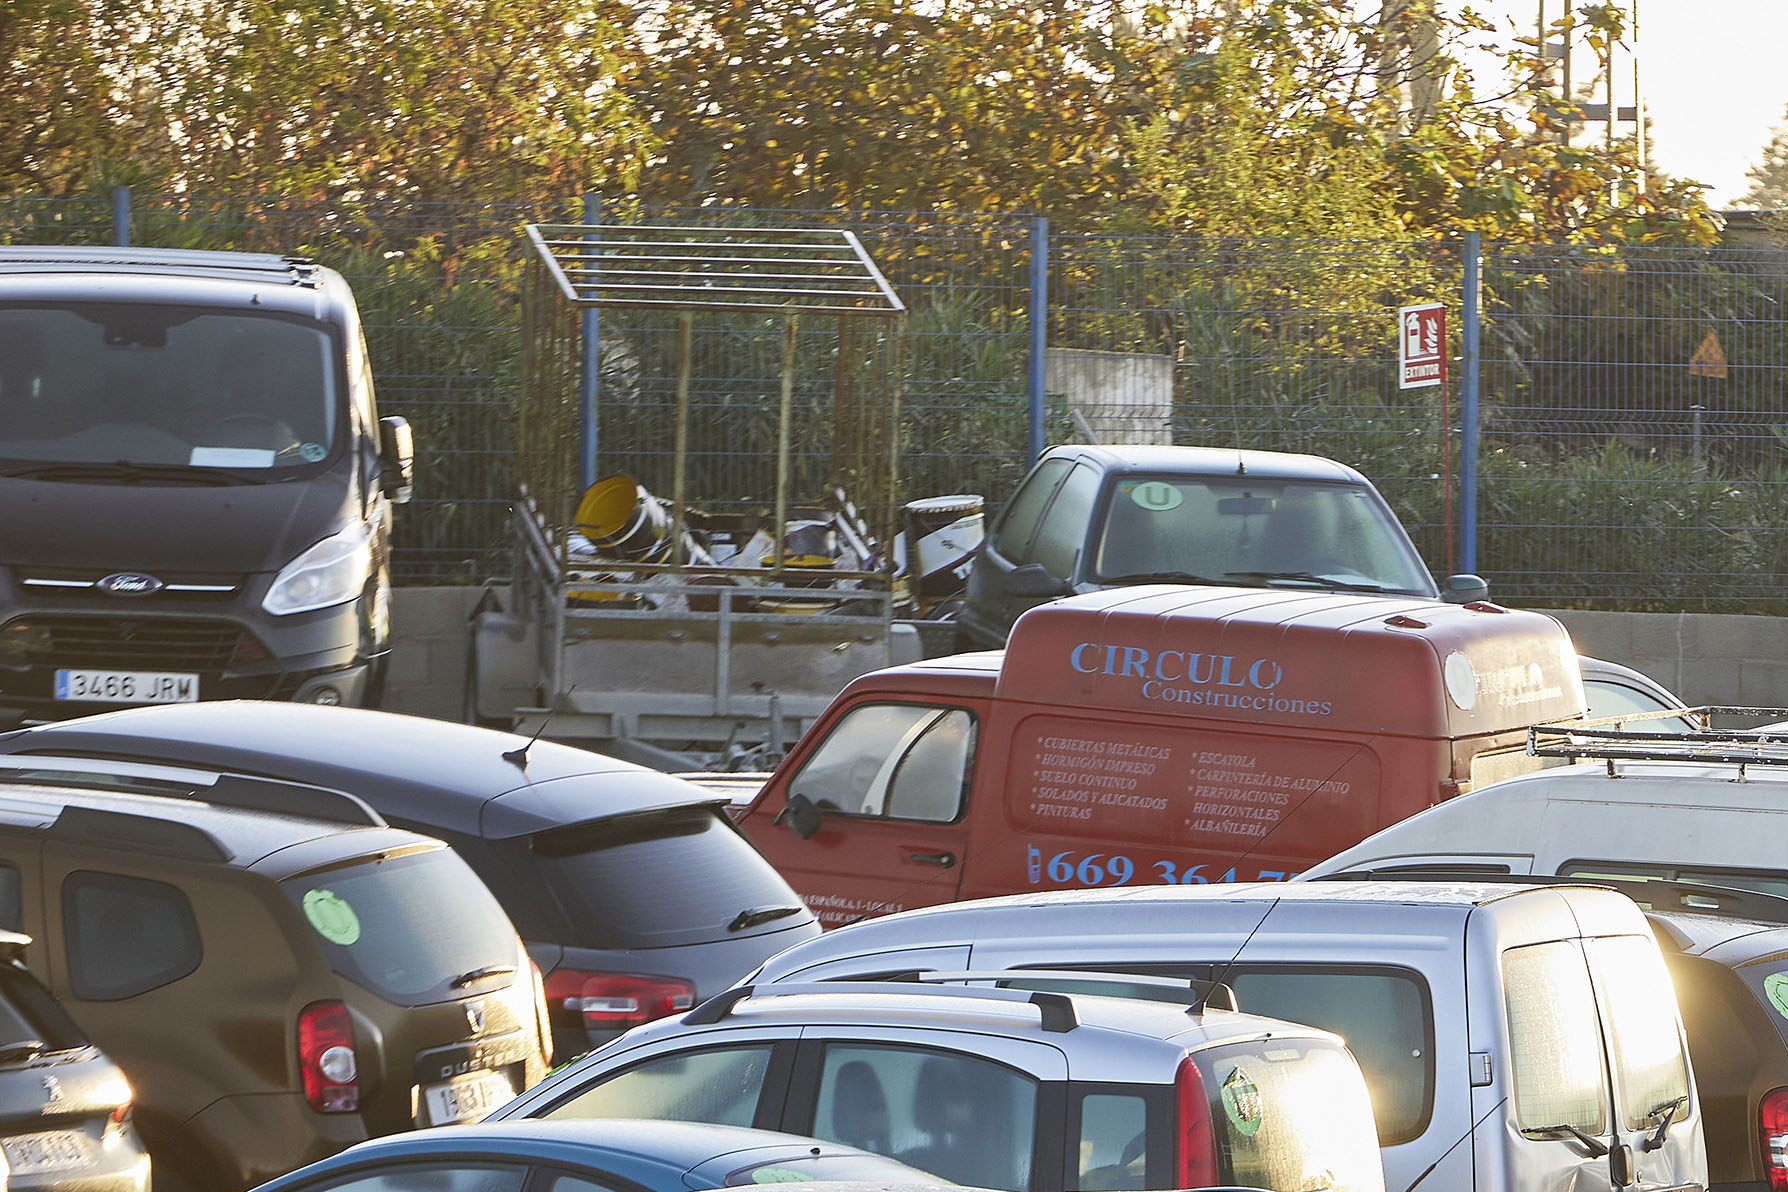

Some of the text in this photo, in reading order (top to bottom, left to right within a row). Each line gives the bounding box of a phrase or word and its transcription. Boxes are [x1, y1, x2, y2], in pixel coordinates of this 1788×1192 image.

[1070, 642, 1282, 690] CIRCULO
[73, 674, 135, 699] 3466
[1142, 680, 1332, 716] Construcciones
[1043, 736, 1172, 760] CUBIERTAS METÁLICAS
[1041, 753, 1156, 775] HORMIGÓN IMPRESO
[1198, 751, 1256, 769] ESCAYOLA
[1039, 769, 1137, 791] SUELO CONTINUO
[1196, 768, 1350, 796] CARPINTERÍA DE ALUMINIO
[1036, 786, 1168, 811] SOLADOS Y ALICATADOS
[1194, 785, 1290, 806] PERFORACIONES
[1036, 803, 1092, 820] PINTURAS
[1192, 801, 1280, 821] HORIZONTALES
[1190, 818, 1268, 838] ALBAÑILERÍA
[1047, 851, 1134, 886] 669
